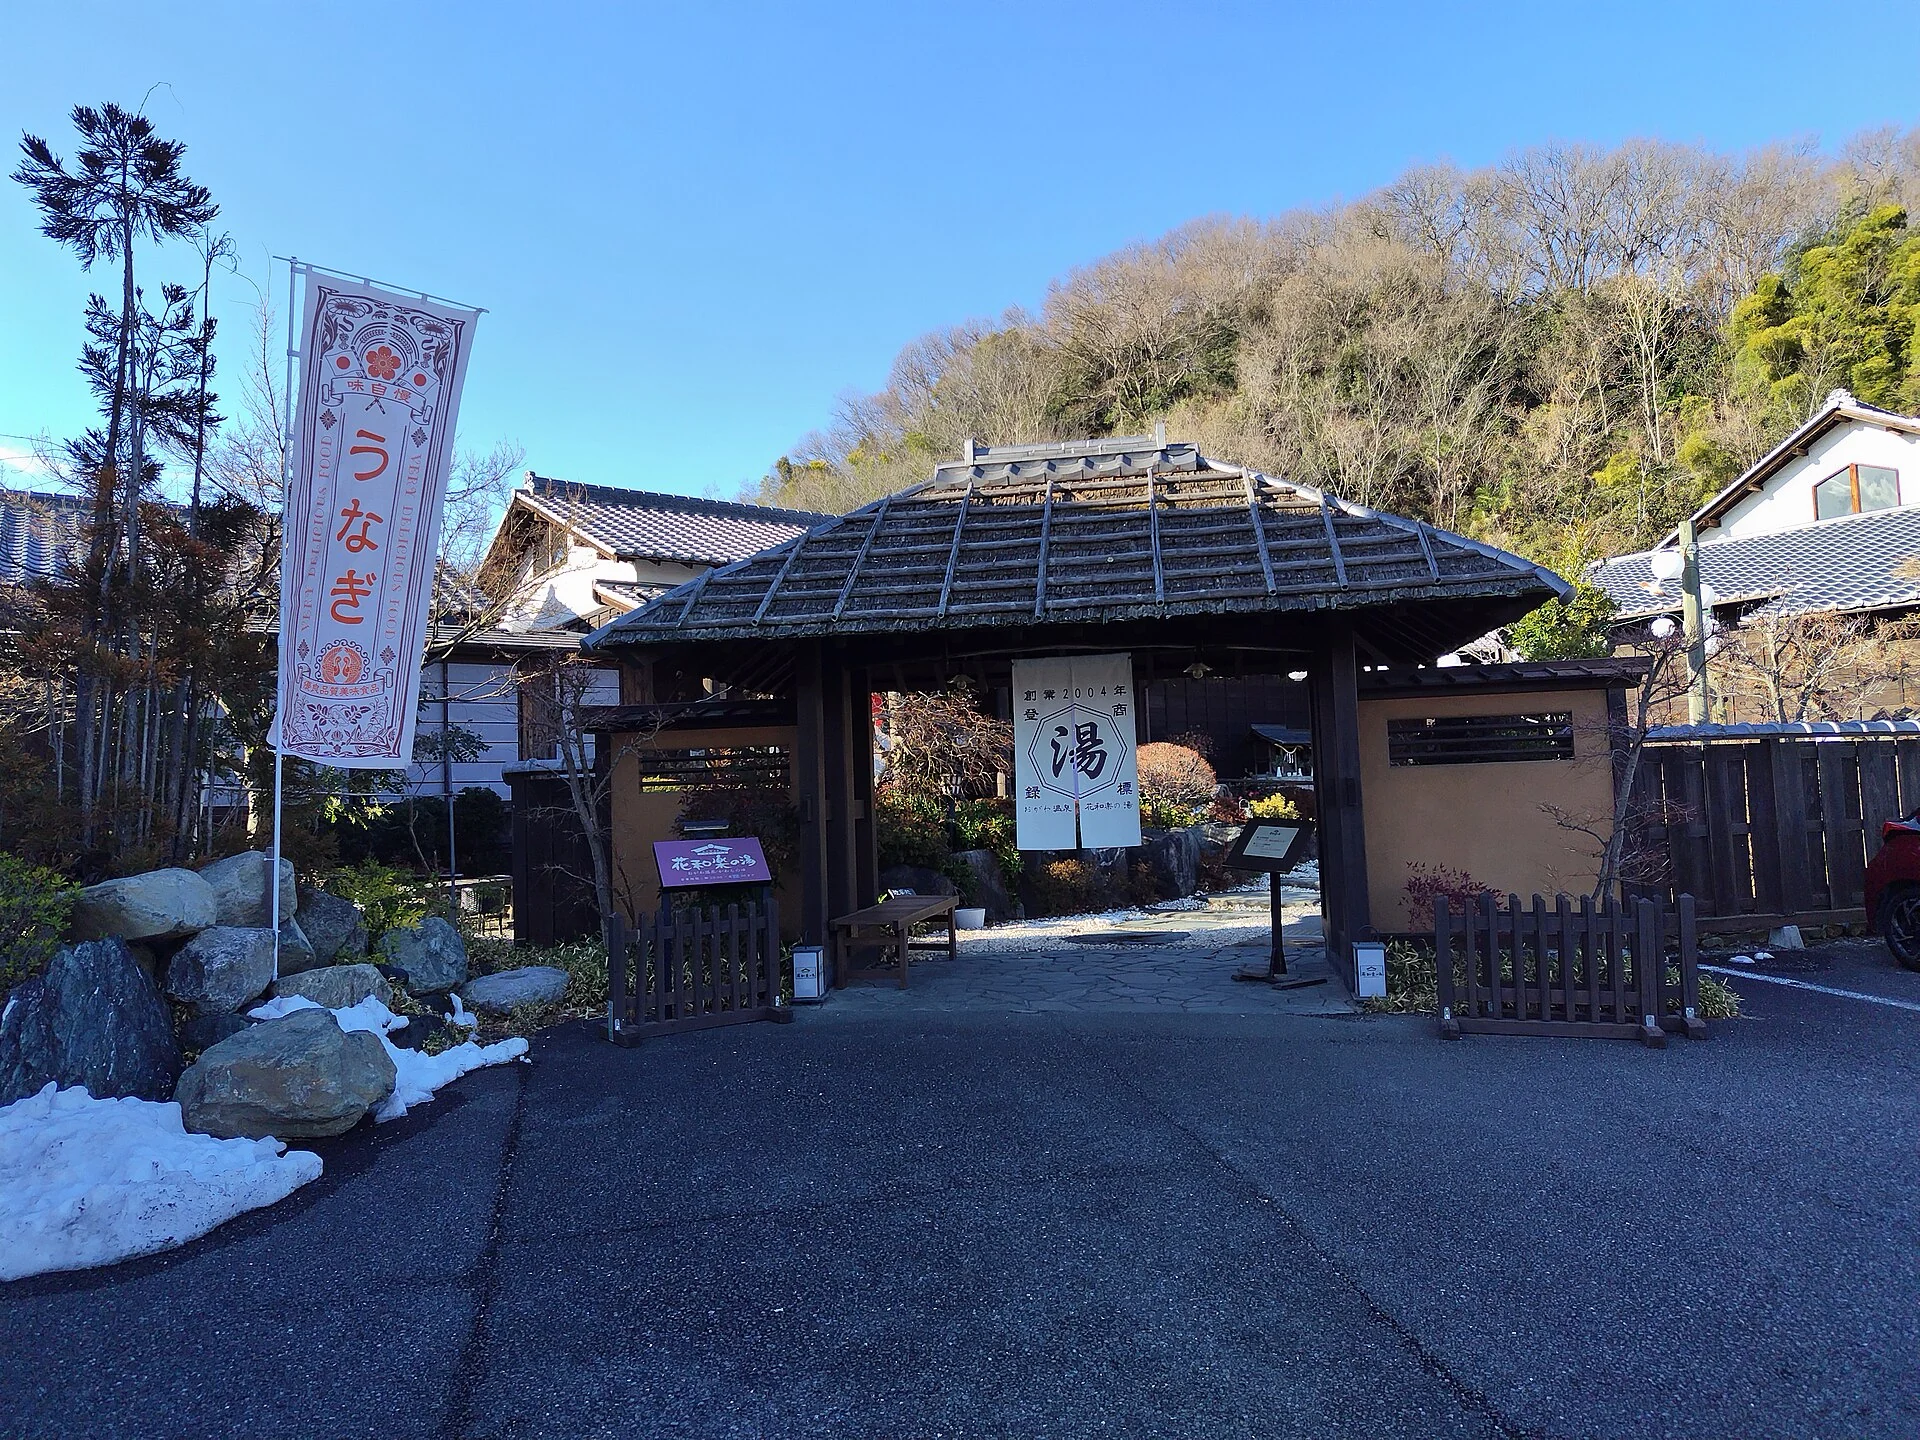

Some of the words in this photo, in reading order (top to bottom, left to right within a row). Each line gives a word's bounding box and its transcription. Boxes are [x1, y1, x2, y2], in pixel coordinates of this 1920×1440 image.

[347, 379, 412, 404] 味自慢
[405, 454, 421, 496] VERY
[301, 587, 314, 632] VERY
[308, 486, 327, 577] DELICIOUS
[318, 435, 333, 479] FOOD
[330, 429, 389, 625] うなぎ
[392, 505, 414, 593] DELICIOUS
[384, 599, 400, 640] FOOD
[1050, 721, 1108, 780] 湯
[671, 854, 757, 871] 花和楽の湯
